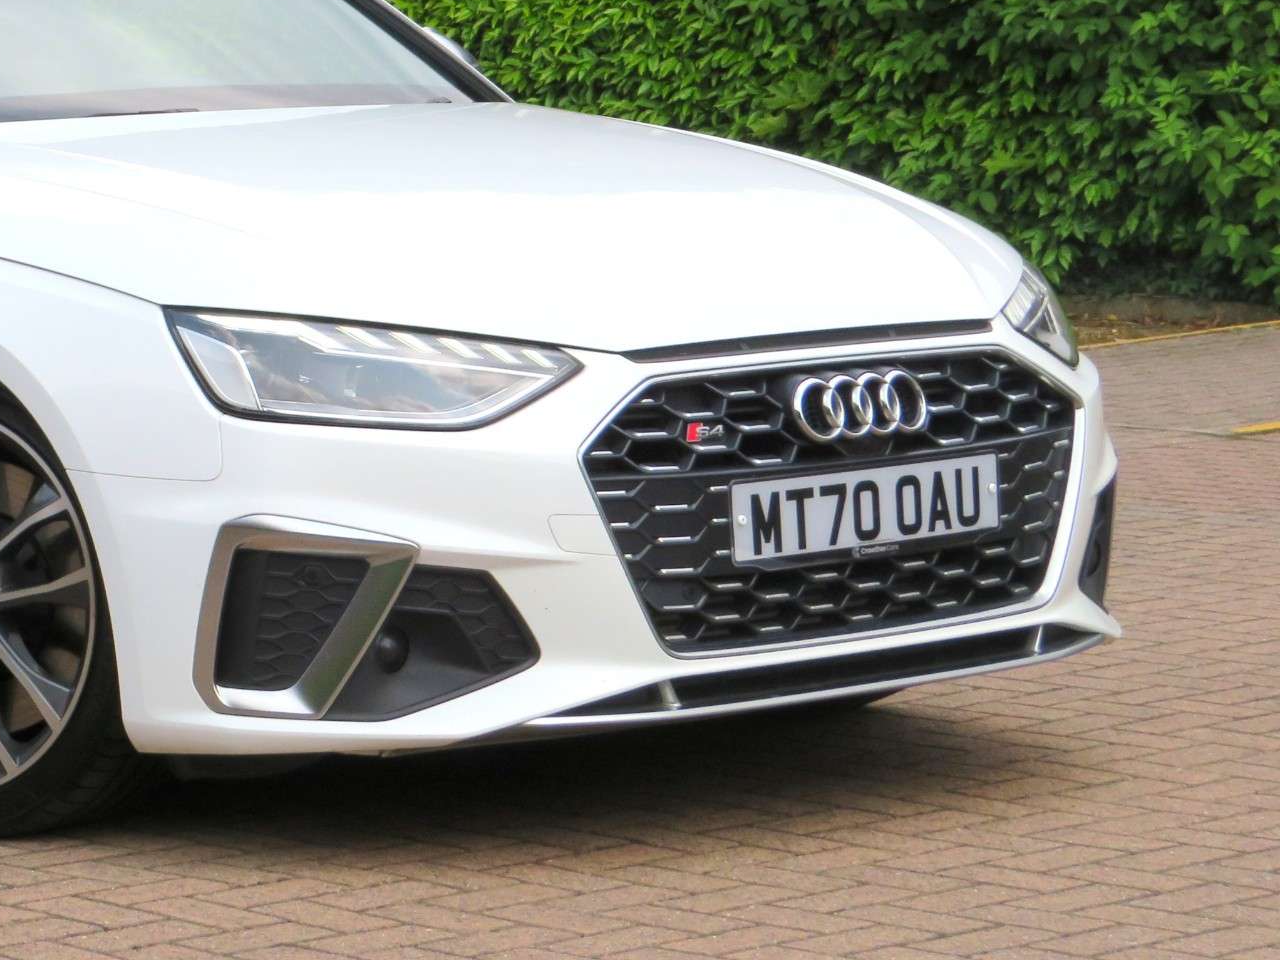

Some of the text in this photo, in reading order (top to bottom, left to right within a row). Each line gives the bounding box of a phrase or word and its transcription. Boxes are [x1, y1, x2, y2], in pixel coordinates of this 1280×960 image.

[694, 423, 724, 438] S4
[750, 466, 981, 556] MT70 OAU
